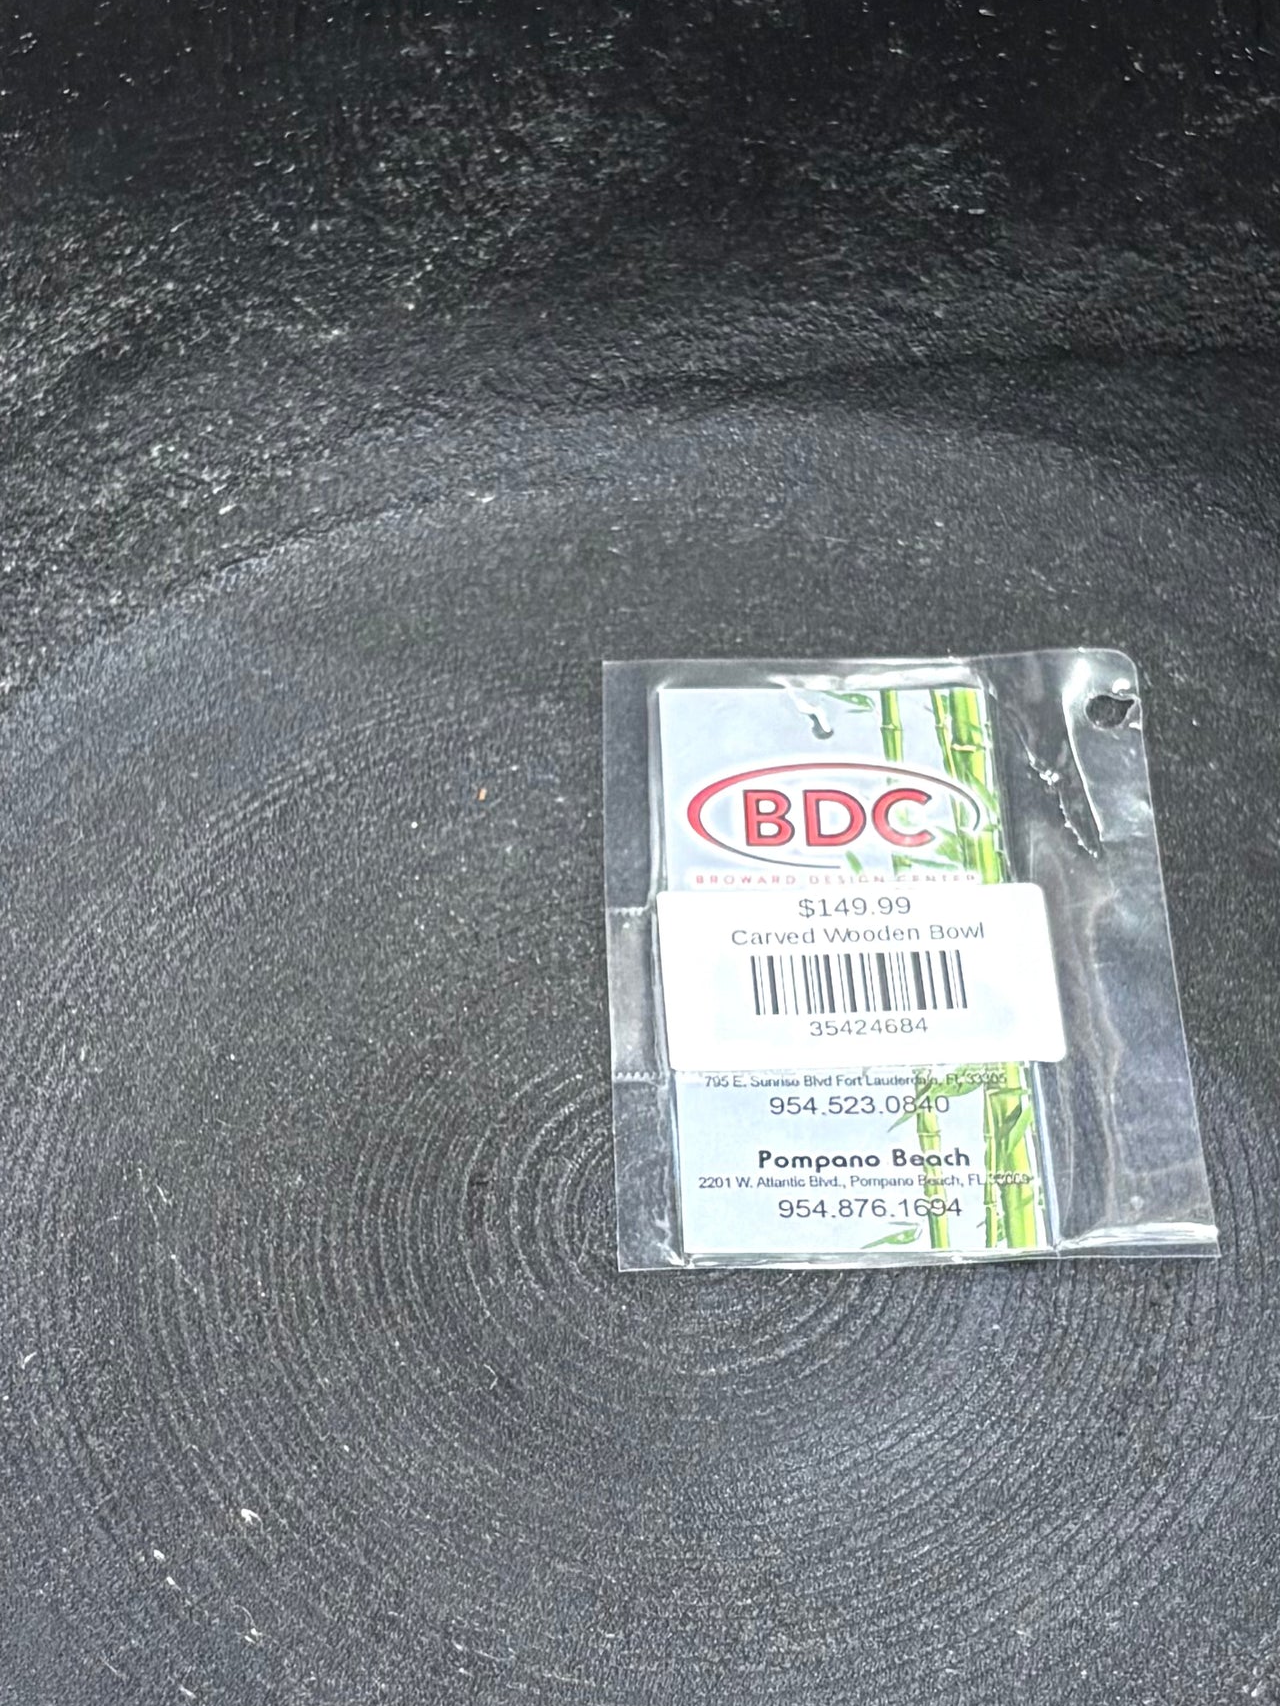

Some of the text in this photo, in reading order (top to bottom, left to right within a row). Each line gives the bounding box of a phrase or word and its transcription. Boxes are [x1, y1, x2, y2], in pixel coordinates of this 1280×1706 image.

[743, 787, 937, 848] BDC
[695, 875, 796, 886] BROWARD
[798, 896, 912, 919] $149.99
[731, 922, 985, 946] Carved Wooden Bowl
[809, 1017, 929, 1037] 35424684
[732, 1074, 748, 1088] E.
[803, 1074, 833, 1087] Blvd
[835, 1074, 863, 1087] Fort
[769, 1095, 950, 1116] 954.523.0840
[758, 1147, 971, 1173] Pompano Beach
[698, 1176, 732, 1189] 2201
[735, 1176, 753, 1189] W.
[756, 1175, 806, 1189] Atlantic
[850, 1175, 914, 1189] Pompano
[778, 1197, 962, 1219] 954.876.1694
